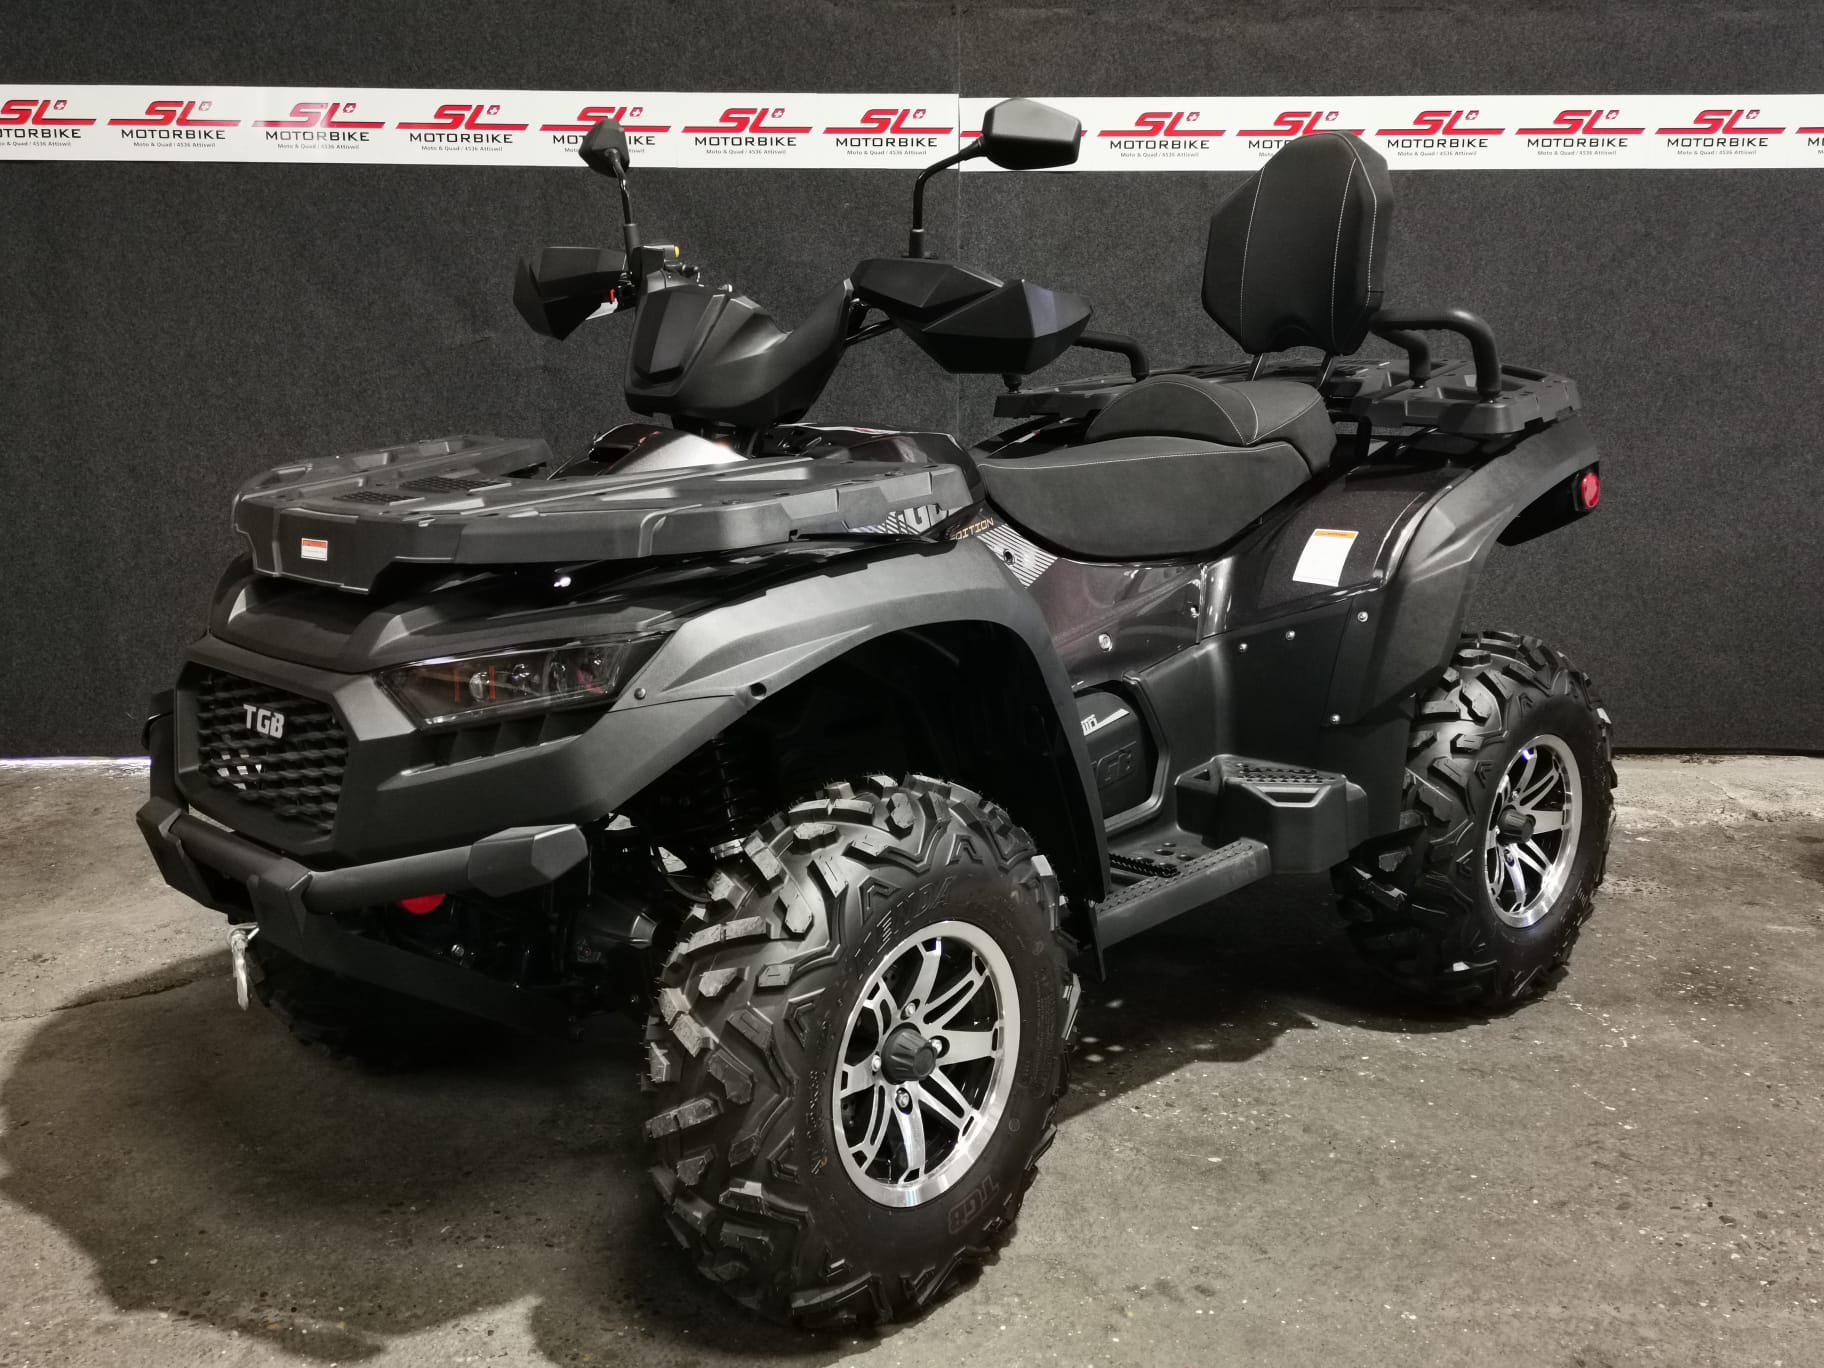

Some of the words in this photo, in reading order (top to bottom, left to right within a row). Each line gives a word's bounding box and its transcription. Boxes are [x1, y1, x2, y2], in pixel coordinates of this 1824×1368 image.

[0, 129, 81, 138] TORBIKE
[121, 129, 226, 139] MOTORBIKE
[265, 131, 370, 141] MOTORBIKE
[409, 133, 513, 143] MOTORBIKE
[694, 137, 797, 146] MOTORBIKE
[836, 138, 937, 147] MOTORBIKE
[1110, 140, 1210, 149] MOTORBIKE
[1387, 139, 1488, 148] MOTORBIKE
[1527, 138, 1628, 147] MOTORBIKE
[1667, 137, 1769, 147] MOTORBIKE
[243, 704, 285, 739] TGB
